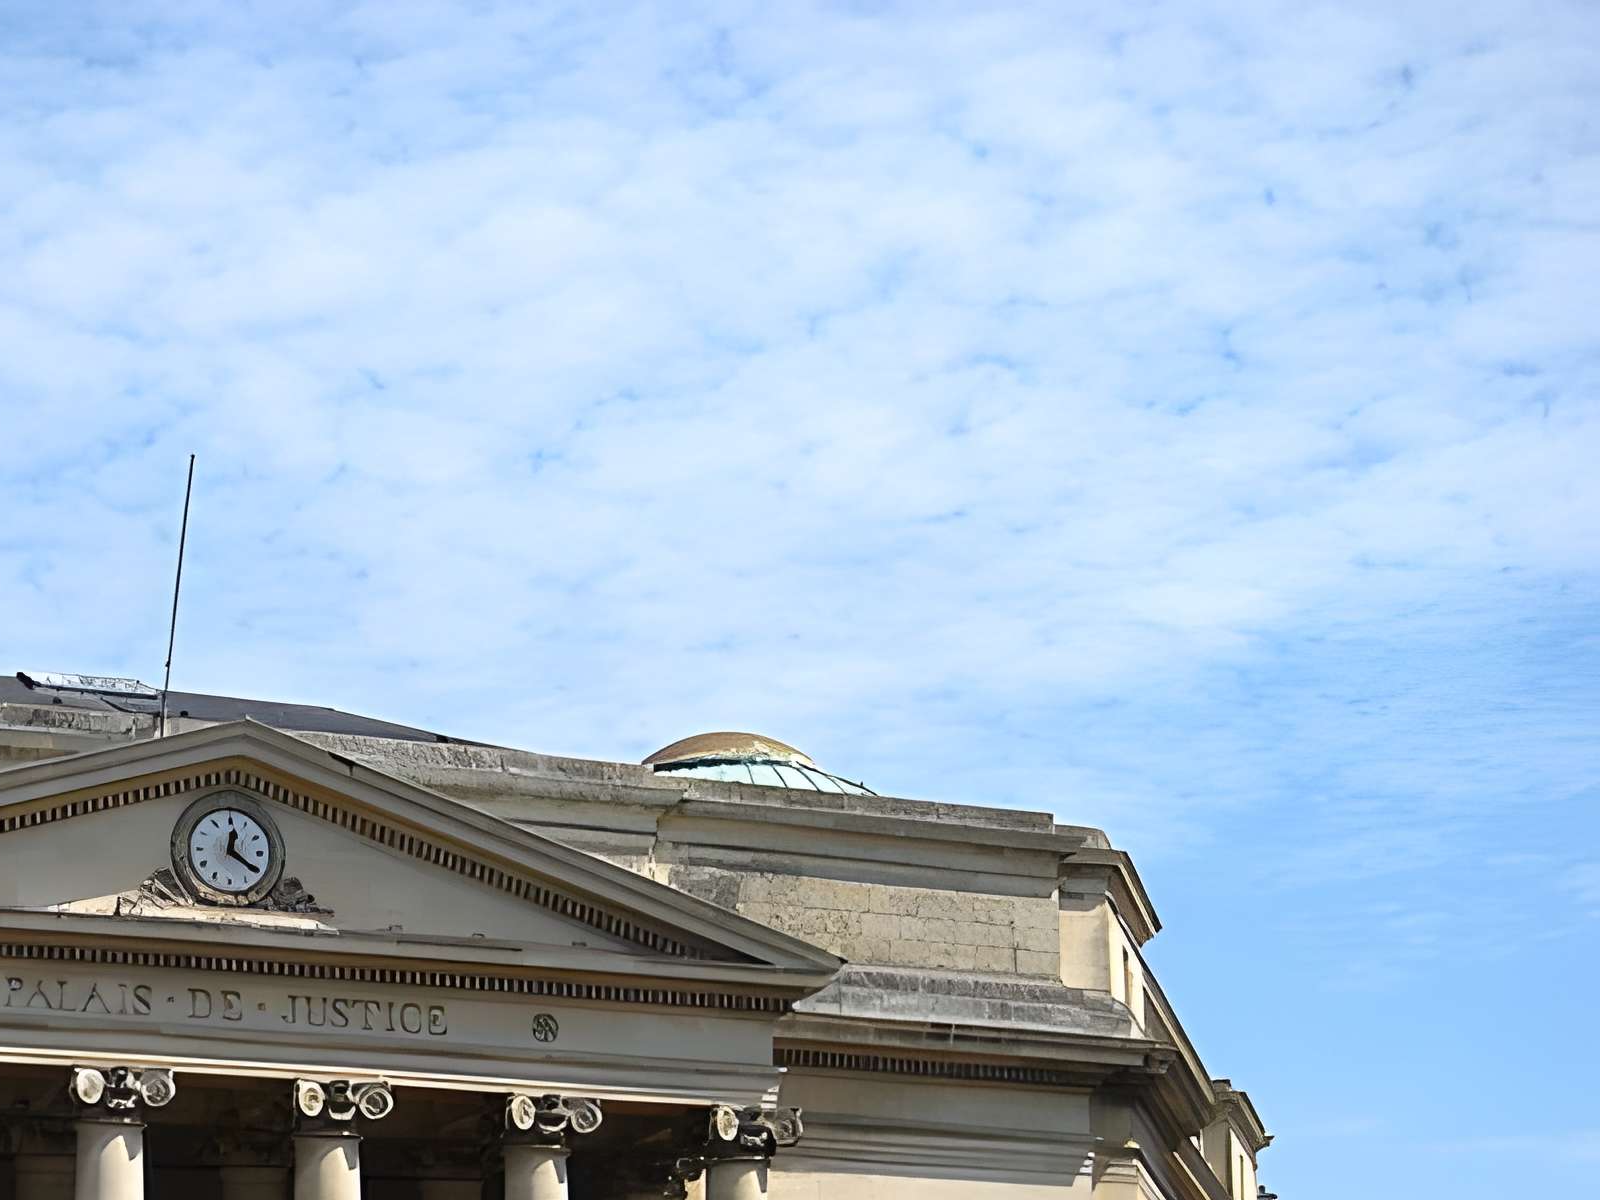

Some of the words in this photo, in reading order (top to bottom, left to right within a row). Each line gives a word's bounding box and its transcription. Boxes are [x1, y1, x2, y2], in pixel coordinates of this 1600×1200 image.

[4, 976, 152, 1015] PALAIS
[187, 987, 242, 1021] DE
[281, 994, 447, 1035] JUSTICE
